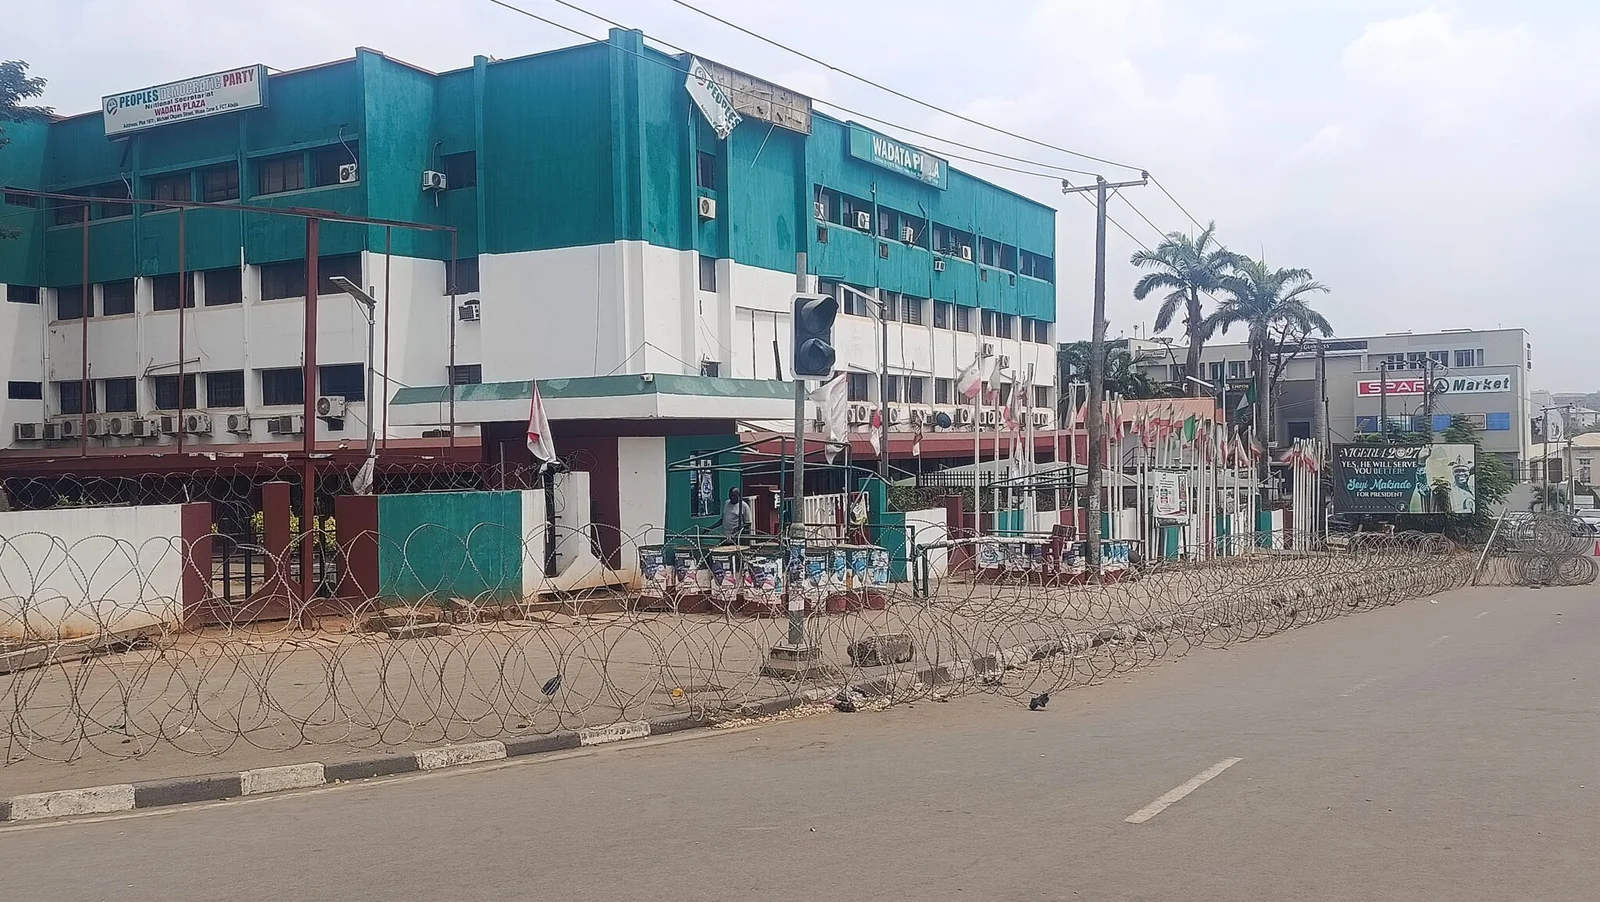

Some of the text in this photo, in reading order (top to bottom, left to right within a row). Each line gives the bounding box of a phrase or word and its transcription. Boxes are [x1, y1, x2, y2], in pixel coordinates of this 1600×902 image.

[119, 69, 255, 108] PEOPLES DEMOCRATIC PARTY
[154, 99, 206, 116] WADATA PLAZA
[706, 82, 741, 127] PEOPLES
[873, 135, 912, 168] WADATA
[912, 152, 940, 179] PLA
[1453, 377, 1510, 392] Market
[1341, 460, 1418, 468] YES, HE WILL SERVE
[1354, 467, 1405, 475] YOU BETTER!
[1346, 478, 1413, 491] Seyi Makinde
